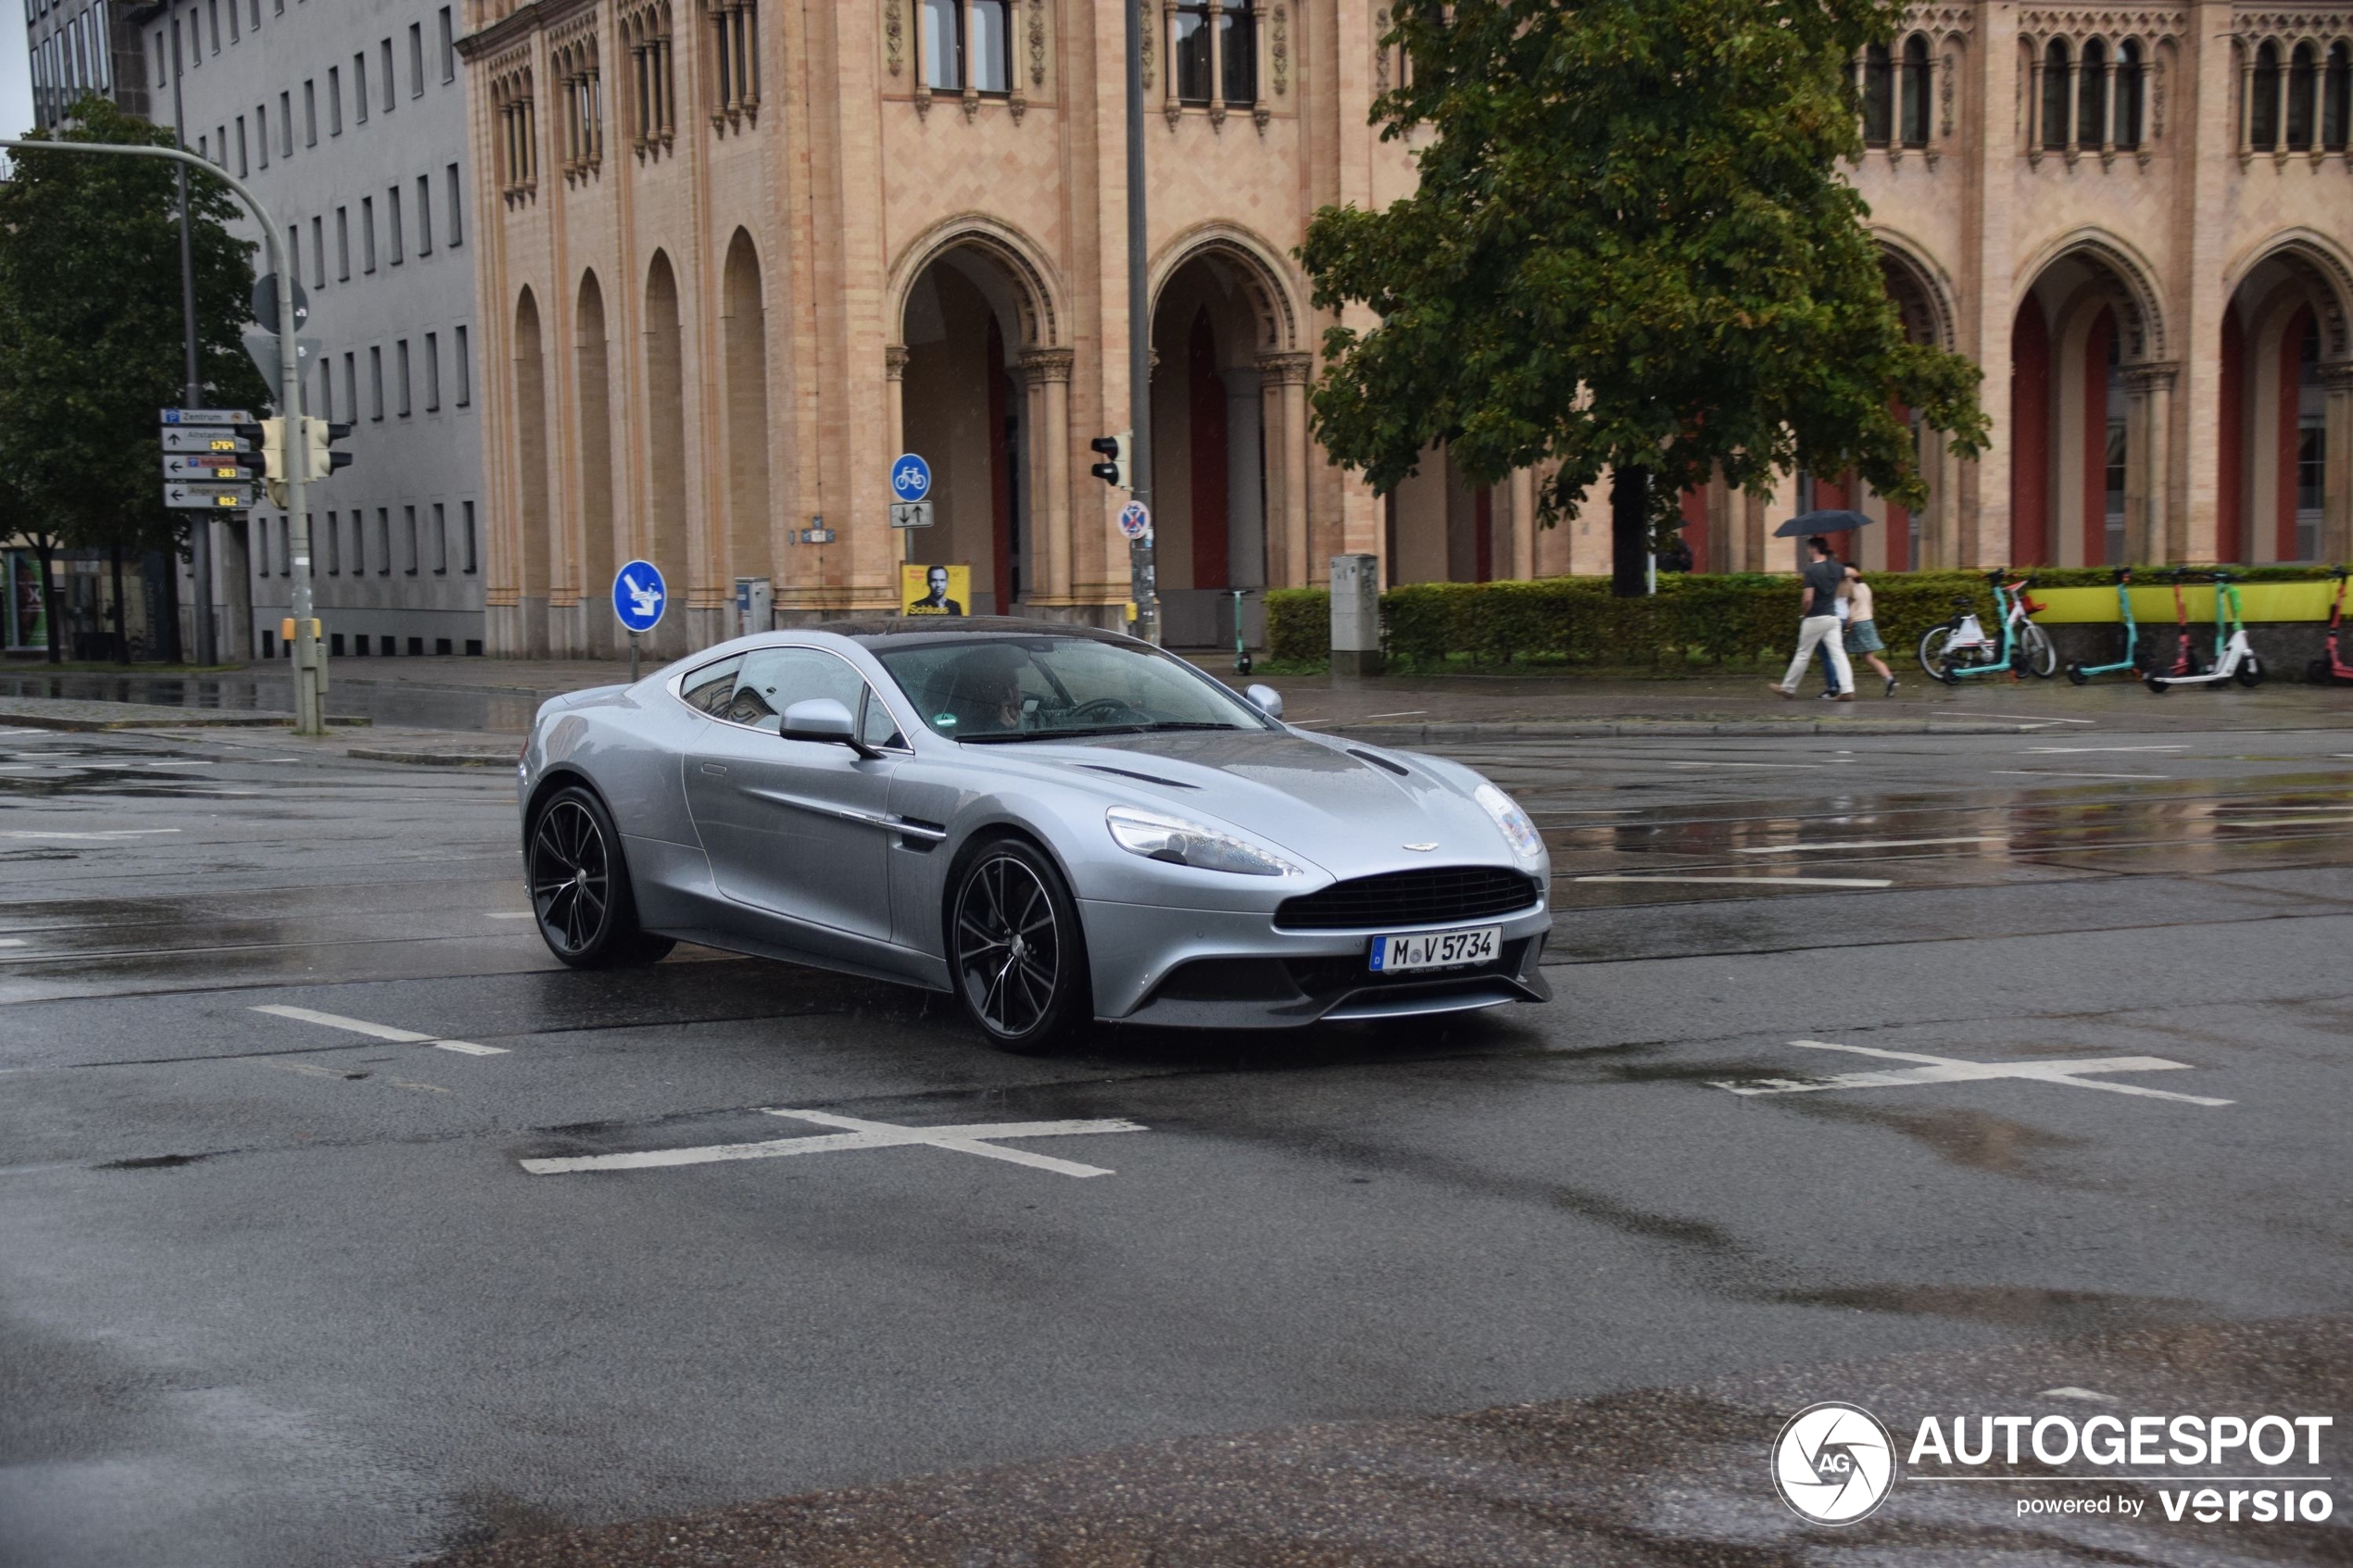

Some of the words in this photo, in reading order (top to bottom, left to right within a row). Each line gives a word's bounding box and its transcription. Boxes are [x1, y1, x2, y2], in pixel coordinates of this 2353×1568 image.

[183, 413, 221, 421] Zentrum
[218, 495, 238, 506] 812
[909, 605, 949, 614] Schluss
[1392, 939, 1410, 965] M
[1425, 936, 1439, 962] V
[1441, 931, 1492, 961] 5734
[1374, 957, 1380, 965] D
